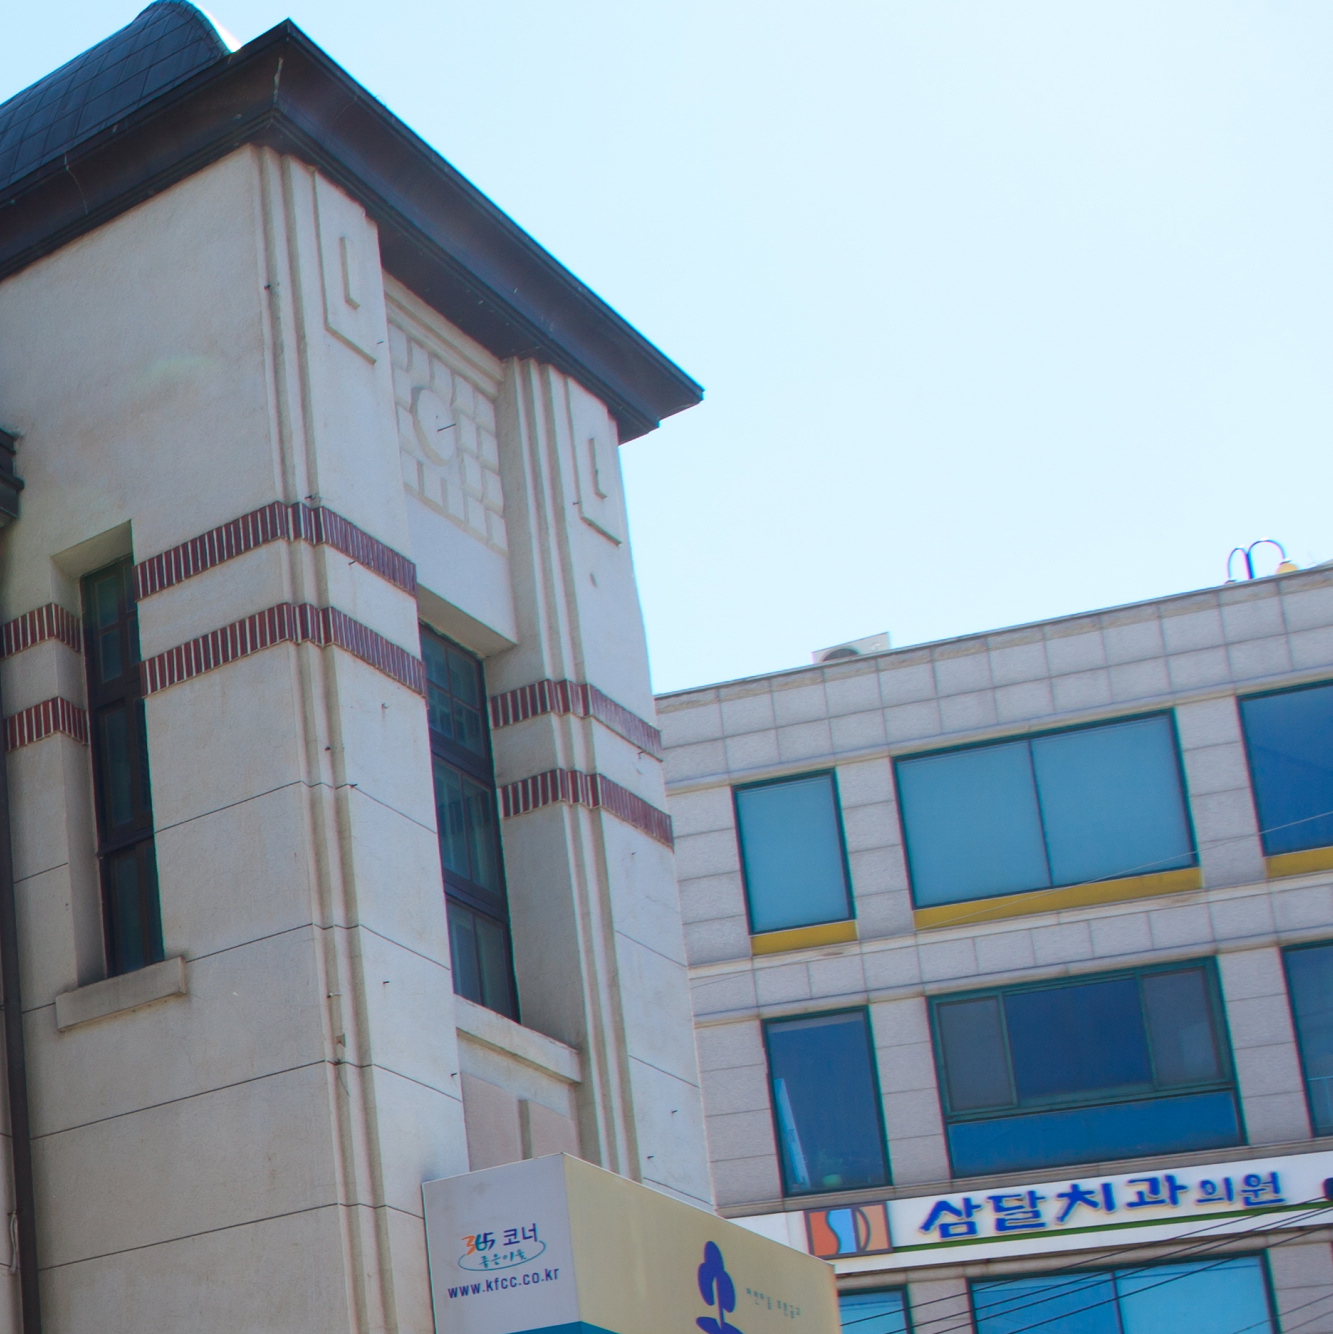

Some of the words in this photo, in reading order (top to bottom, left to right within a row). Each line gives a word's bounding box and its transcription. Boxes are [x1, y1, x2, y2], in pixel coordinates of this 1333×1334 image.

[919, 1171, 1287, 1240] 삼달치과의원
[461, 1232, 495, 1255] 365
[503, 1223, 537, 1246] 코너
[448, 1268, 559, 1299] www.kfcc.co.kr
